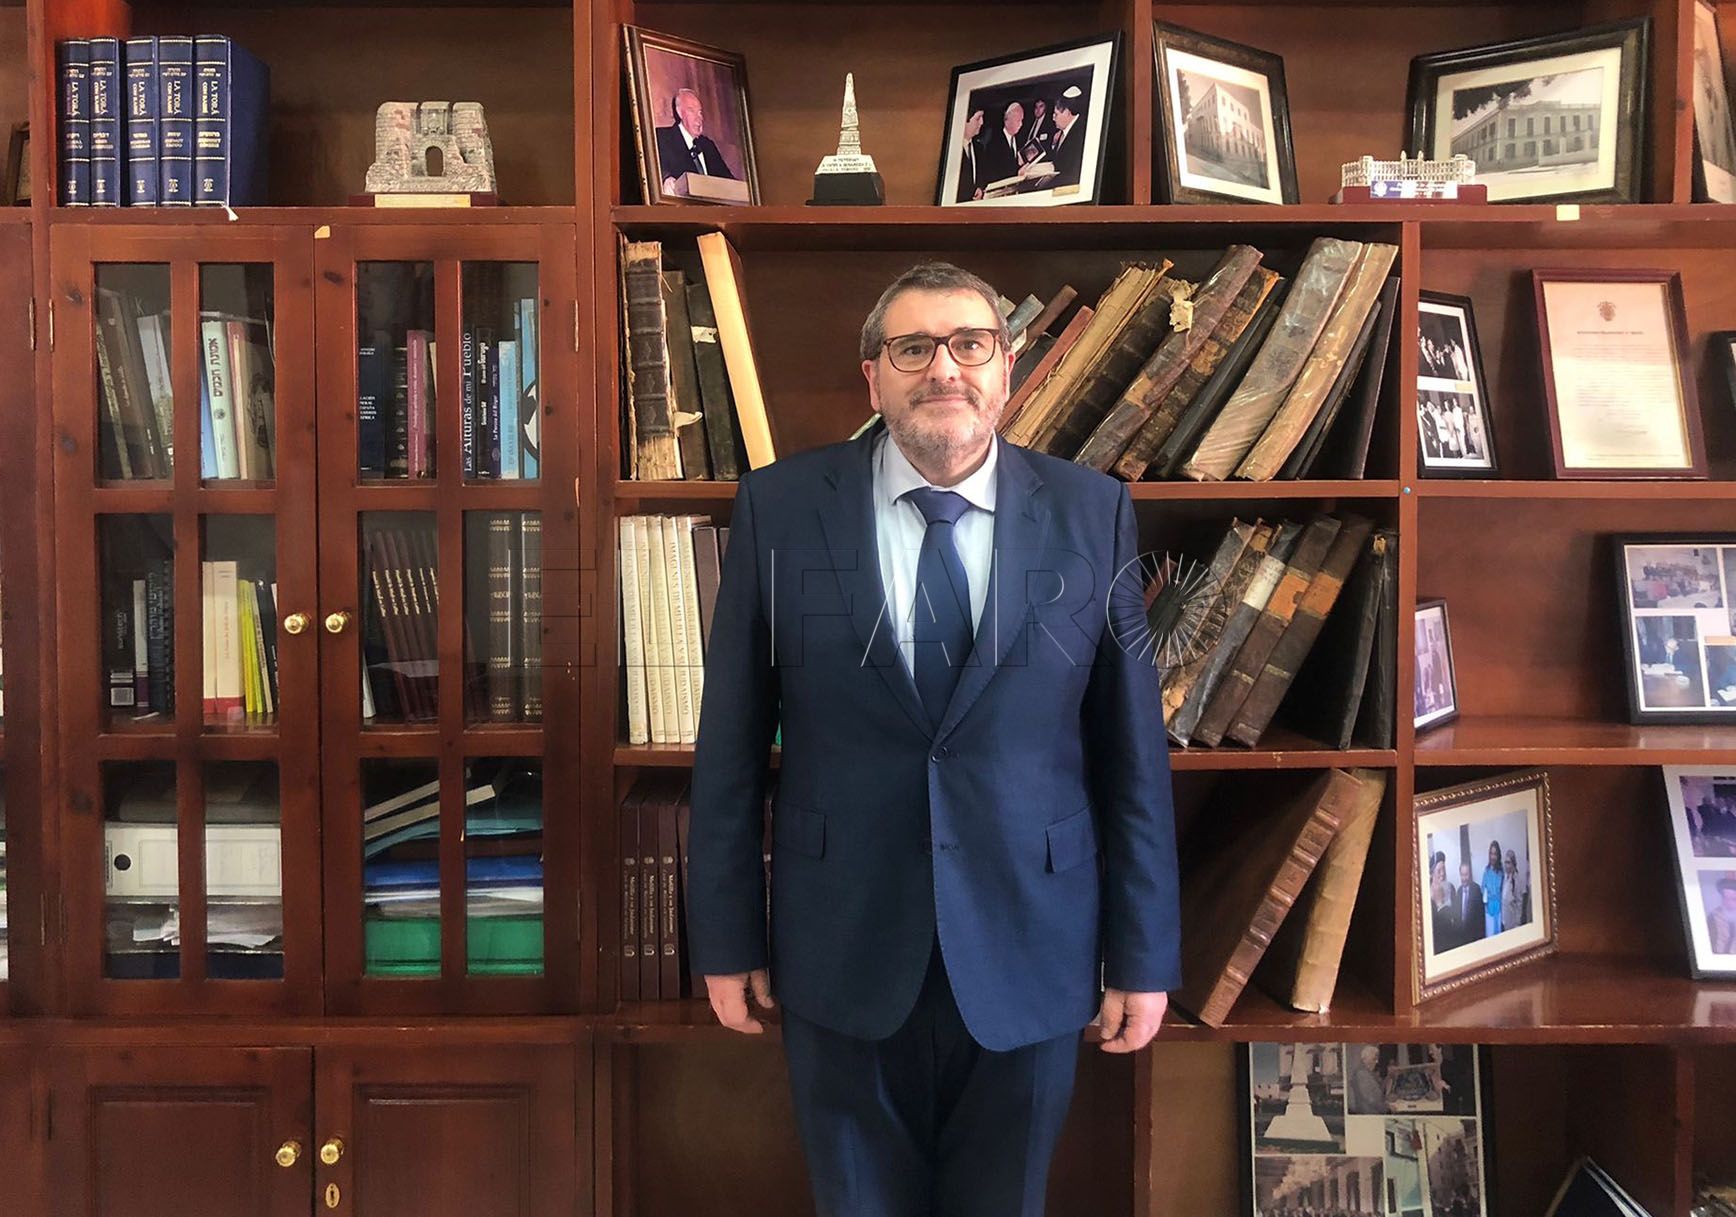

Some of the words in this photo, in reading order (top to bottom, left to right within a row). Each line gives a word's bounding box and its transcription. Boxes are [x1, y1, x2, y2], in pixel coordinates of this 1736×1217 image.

[72, 82, 78, 92] LA
[100, 80, 106, 90] LA
[138, 82, 145, 91] LA
[174, 80, 180, 91] LA
[211, 81, 218, 91] LA
[463, 332, 472, 376] Pueblo
[466, 381, 472, 391] mi
[466, 393, 472, 405] de
[463, 406, 473, 454] Alturas
[464, 454, 472, 472] Las
[675, 604, 683, 644] MELILLA
[680, 672, 689, 715] JUDAISMO
